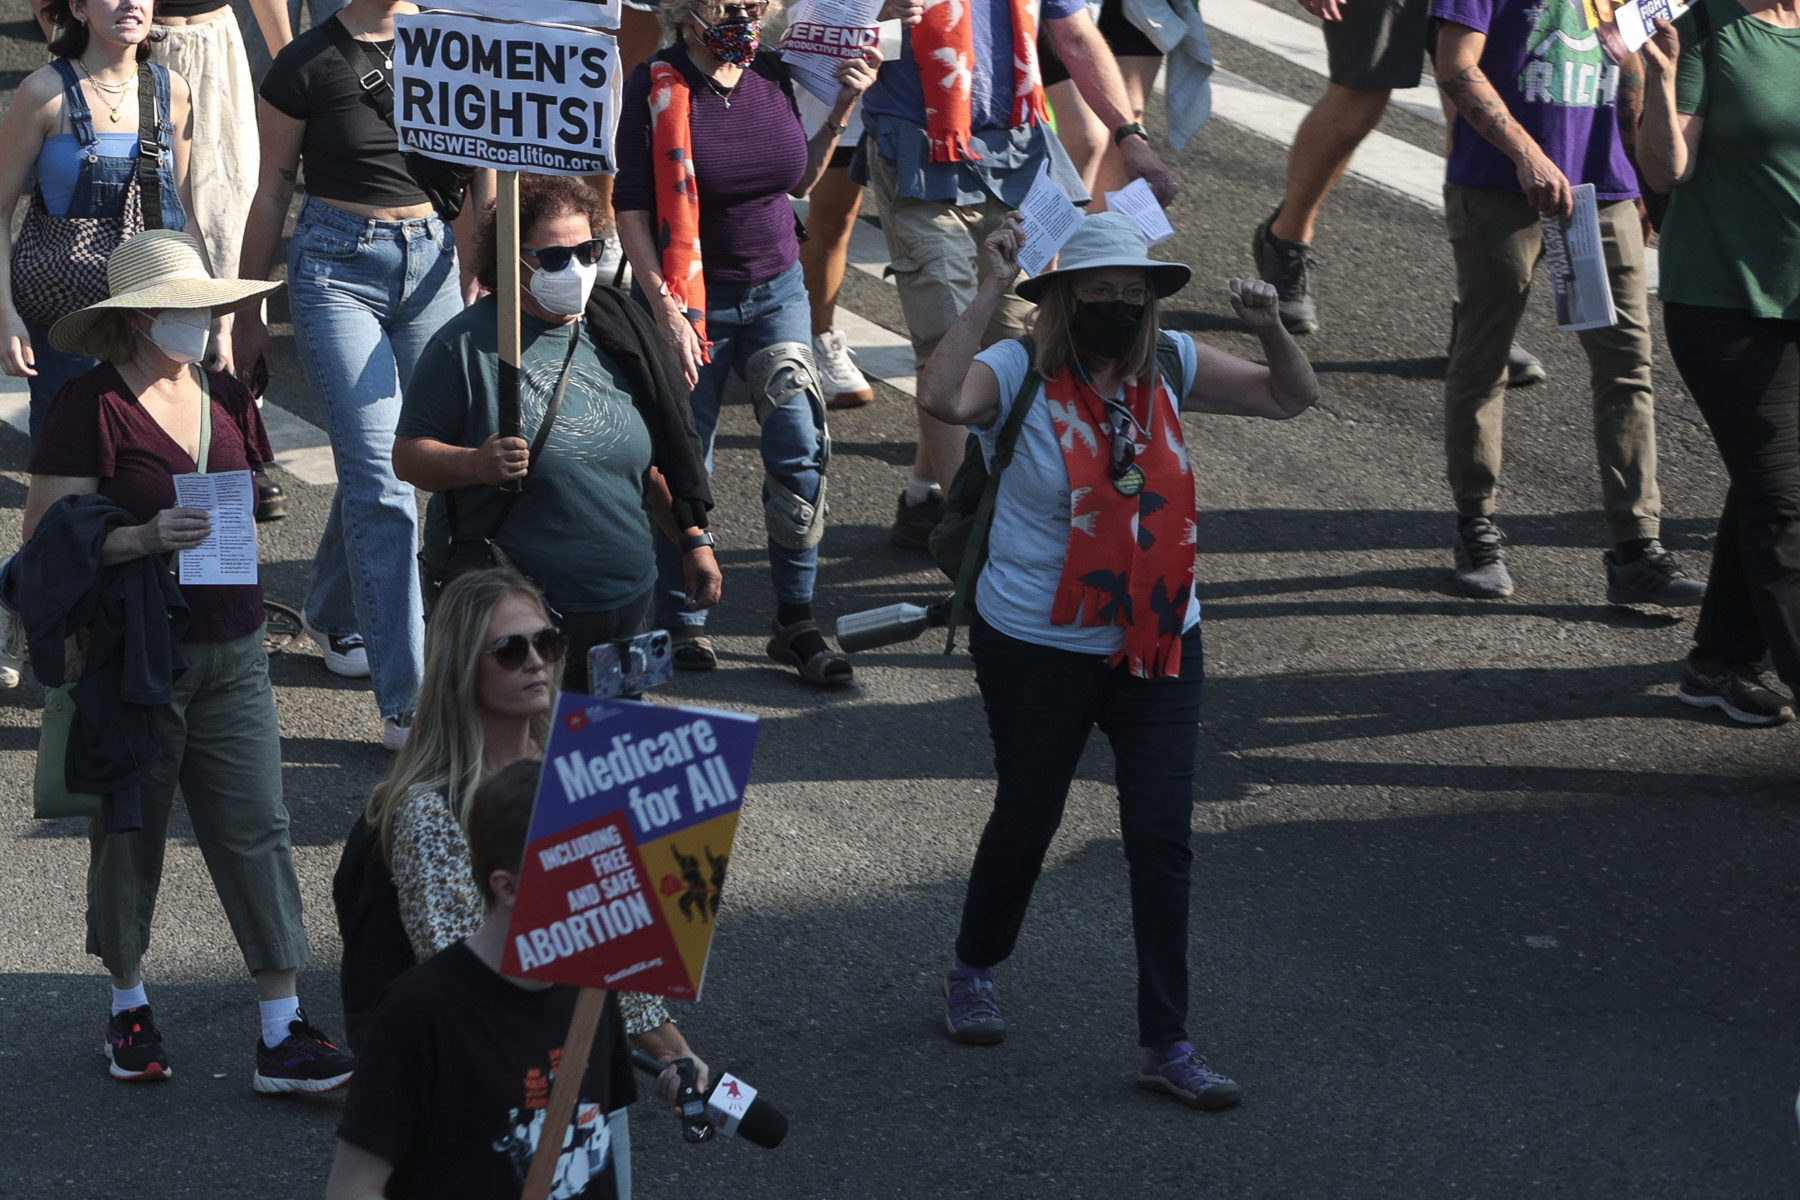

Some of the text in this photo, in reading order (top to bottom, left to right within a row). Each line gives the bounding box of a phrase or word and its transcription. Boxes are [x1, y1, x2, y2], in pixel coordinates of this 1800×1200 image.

[398, 27, 608, 90] WOMEN'S
[403, 76, 604, 149] RIGHTS!
[406, 129, 601, 172] ANSWERcoalition.org
[554, 718, 719, 804] Medicare
[628, 754, 738, 834] for All
[537, 823, 624, 873] INCLUDING
[590, 845, 633, 879] FREE
[566, 867, 642, 914] AND SAFE
[514, 891, 655, 973] ABORTION
